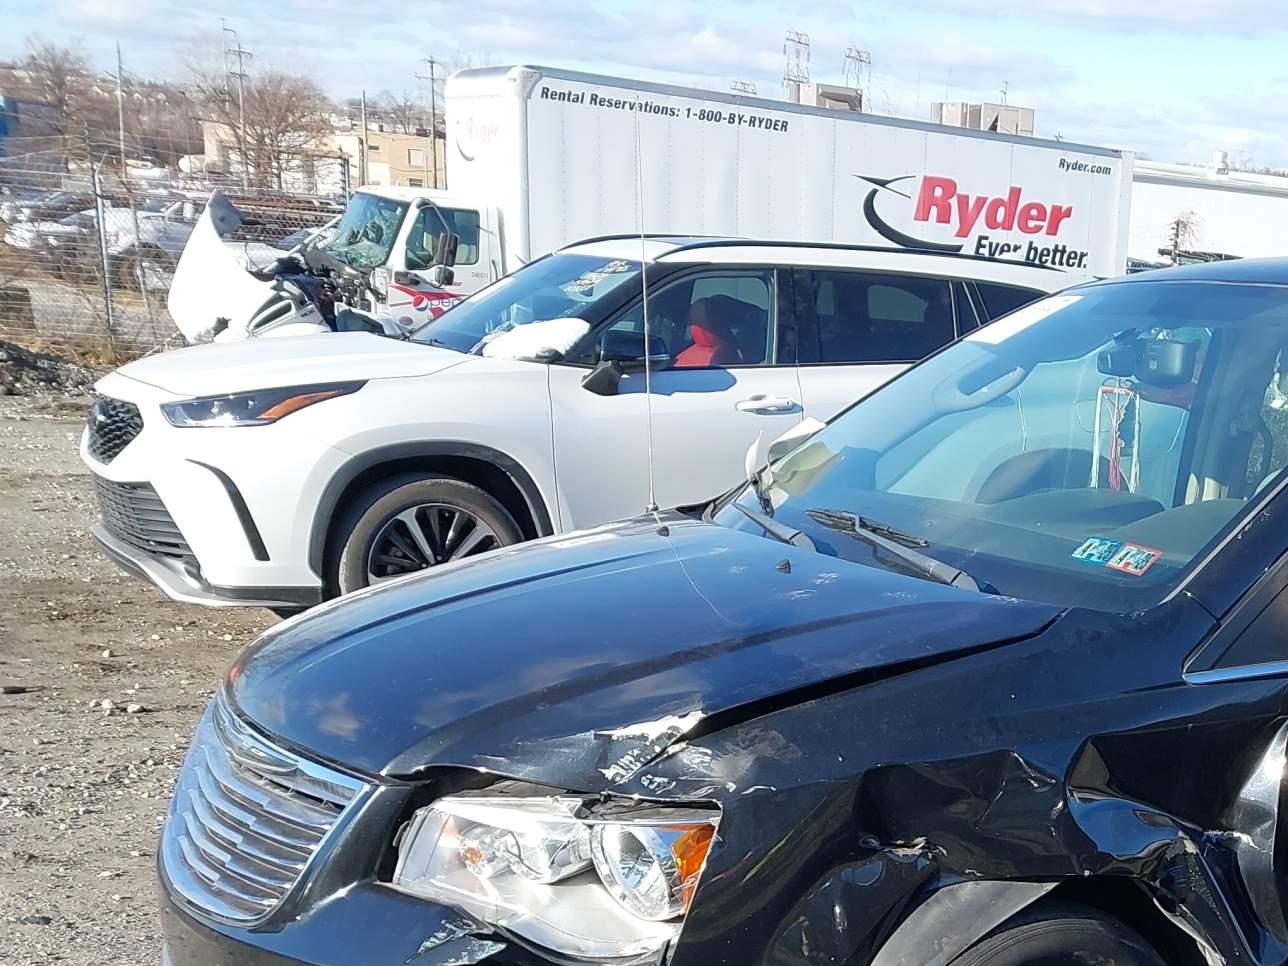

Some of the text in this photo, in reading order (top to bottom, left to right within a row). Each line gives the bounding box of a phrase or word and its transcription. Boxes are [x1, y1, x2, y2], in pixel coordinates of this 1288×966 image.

[540, 86, 789, 132] Rental Reservations: 1-800-BY-RYDER
[1058, 158, 1112, 176] Ryder.com
[913, 175, 1073, 238] Ryder
[974, 234, 1089, 269] Ever better.
